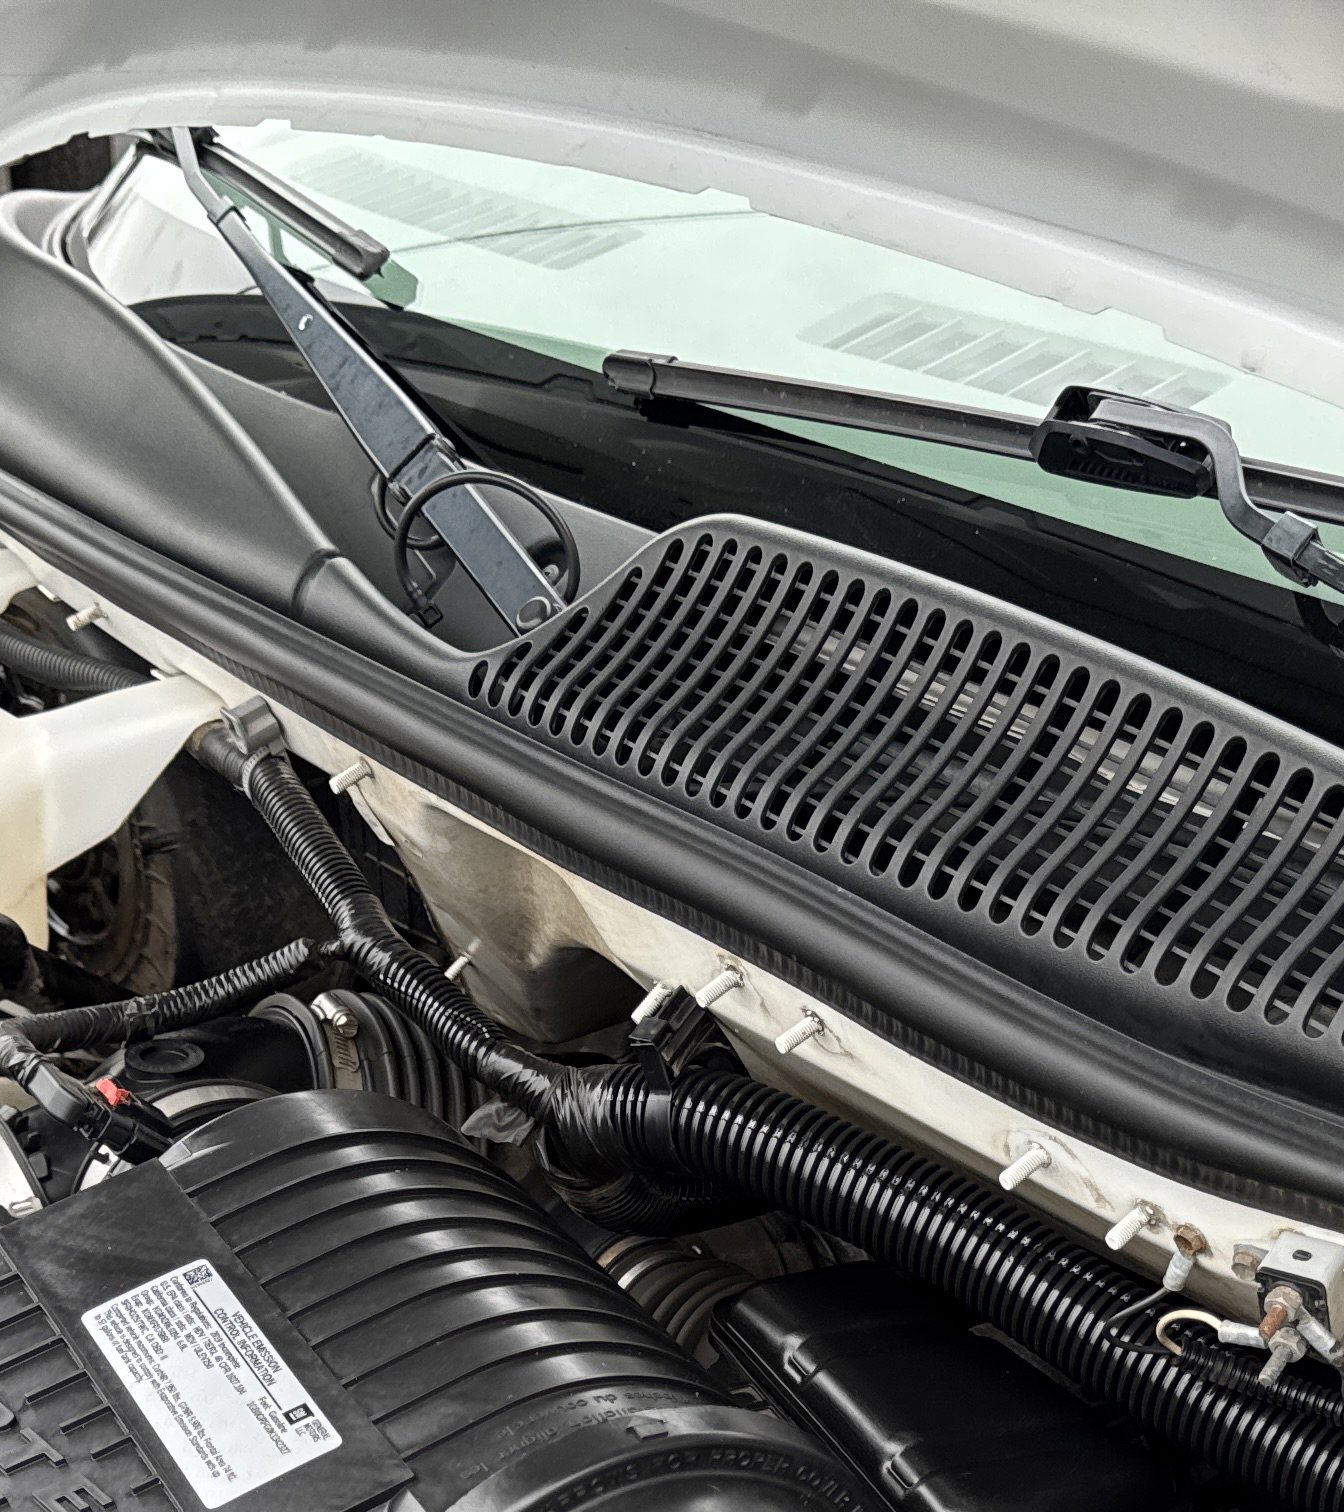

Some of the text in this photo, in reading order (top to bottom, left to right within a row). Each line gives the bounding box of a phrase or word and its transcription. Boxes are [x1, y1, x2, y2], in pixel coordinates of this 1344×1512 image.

[211, 1306, 278, 1386] CONTROL INFORMATION
[229, 1311, 283, 1374] VEHICLE EMISSION
[708, 1447, 790, 1475] PROPER
